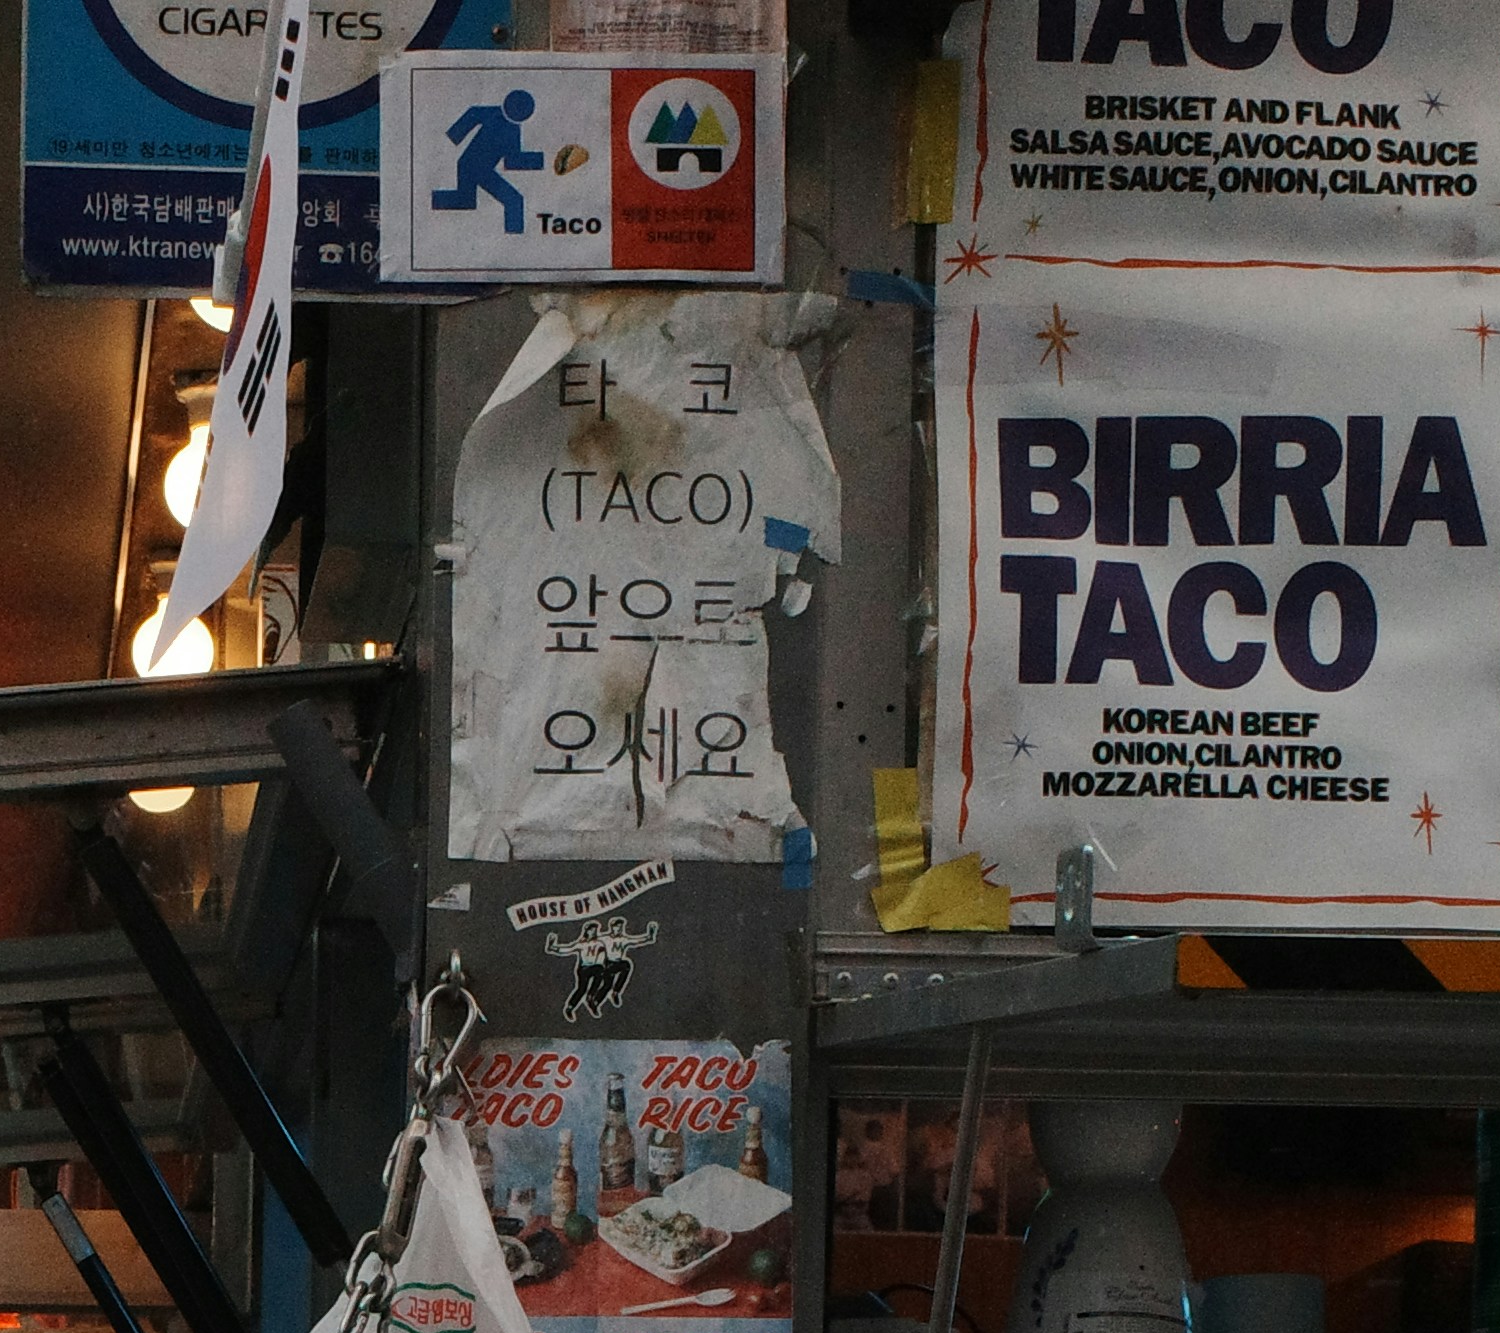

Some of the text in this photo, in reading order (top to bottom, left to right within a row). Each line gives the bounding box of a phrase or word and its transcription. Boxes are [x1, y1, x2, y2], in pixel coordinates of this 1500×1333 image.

[159, 7, 383, 41] CIGARTES
[1084, 94, 1401, 131] BRISKET AND FLANK
[1010, 129, 1125, 158] SALSA
[1376, 138, 1479, 167] SAUCE
[1010, 165, 1125, 194] WHITE
[537, 213, 602, 235] Taco
[540, 467, 755, 530] (TACO)
[1000, 415, 1488, 547] BIRRIA
[536, 573, 758, 654] 앞으로
[1000, 554, 1379, 692] TACO
[1102, 708, 1320, 738] KOREAN BEEF
[530, 707, 754, 779] 오세요
[1092, 741, 1343, 773] ONION,CILANTRO
[1041, 770, 1391, 803] MOZZARELLA CHEESE
[516, 900, 568, 925] HOUSE
[574, 897, 591, 915] OF
[460, 1053, 582, 1090] LDIES
[638, 1096, 749, 1133] RICE
